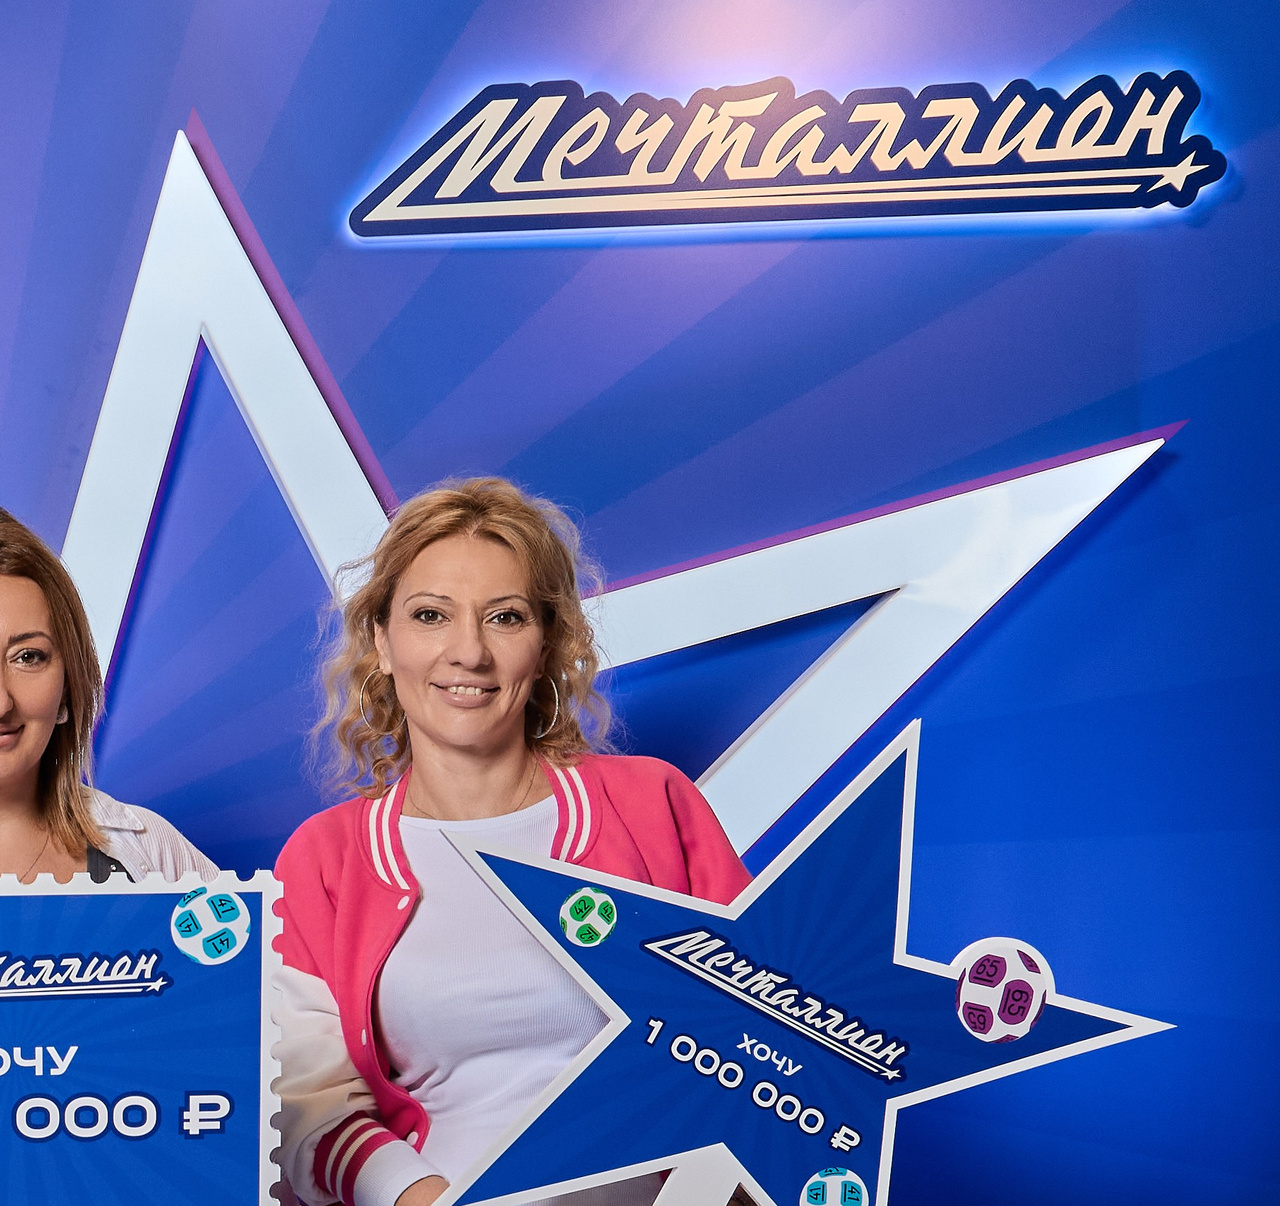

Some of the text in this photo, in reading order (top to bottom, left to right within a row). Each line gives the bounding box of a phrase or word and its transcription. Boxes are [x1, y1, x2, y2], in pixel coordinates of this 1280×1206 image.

[363, 86, 1210, 222] Мечталлион
[218, 899, 235, 913] 41
[574, 899, 590, 915] 42
[976, 958, 1000, 977] 65
[644, 930, 905, 1080] Мечталлион
[1008, 989, 1029, 1016] 65
[968, 1012, 986, 1030] 65
[736, 1033, 802, 1076] ХОЧУ
[647, 1018, 664, 1045] 1
[671, 1035, 744, 1088] 000
[752, 1082, 824, 1134] 000
[16, 1095, 157, 1138] 000
[809, 1188, 821, 1200] 41
[848, 1186, 860, 1201] 41
